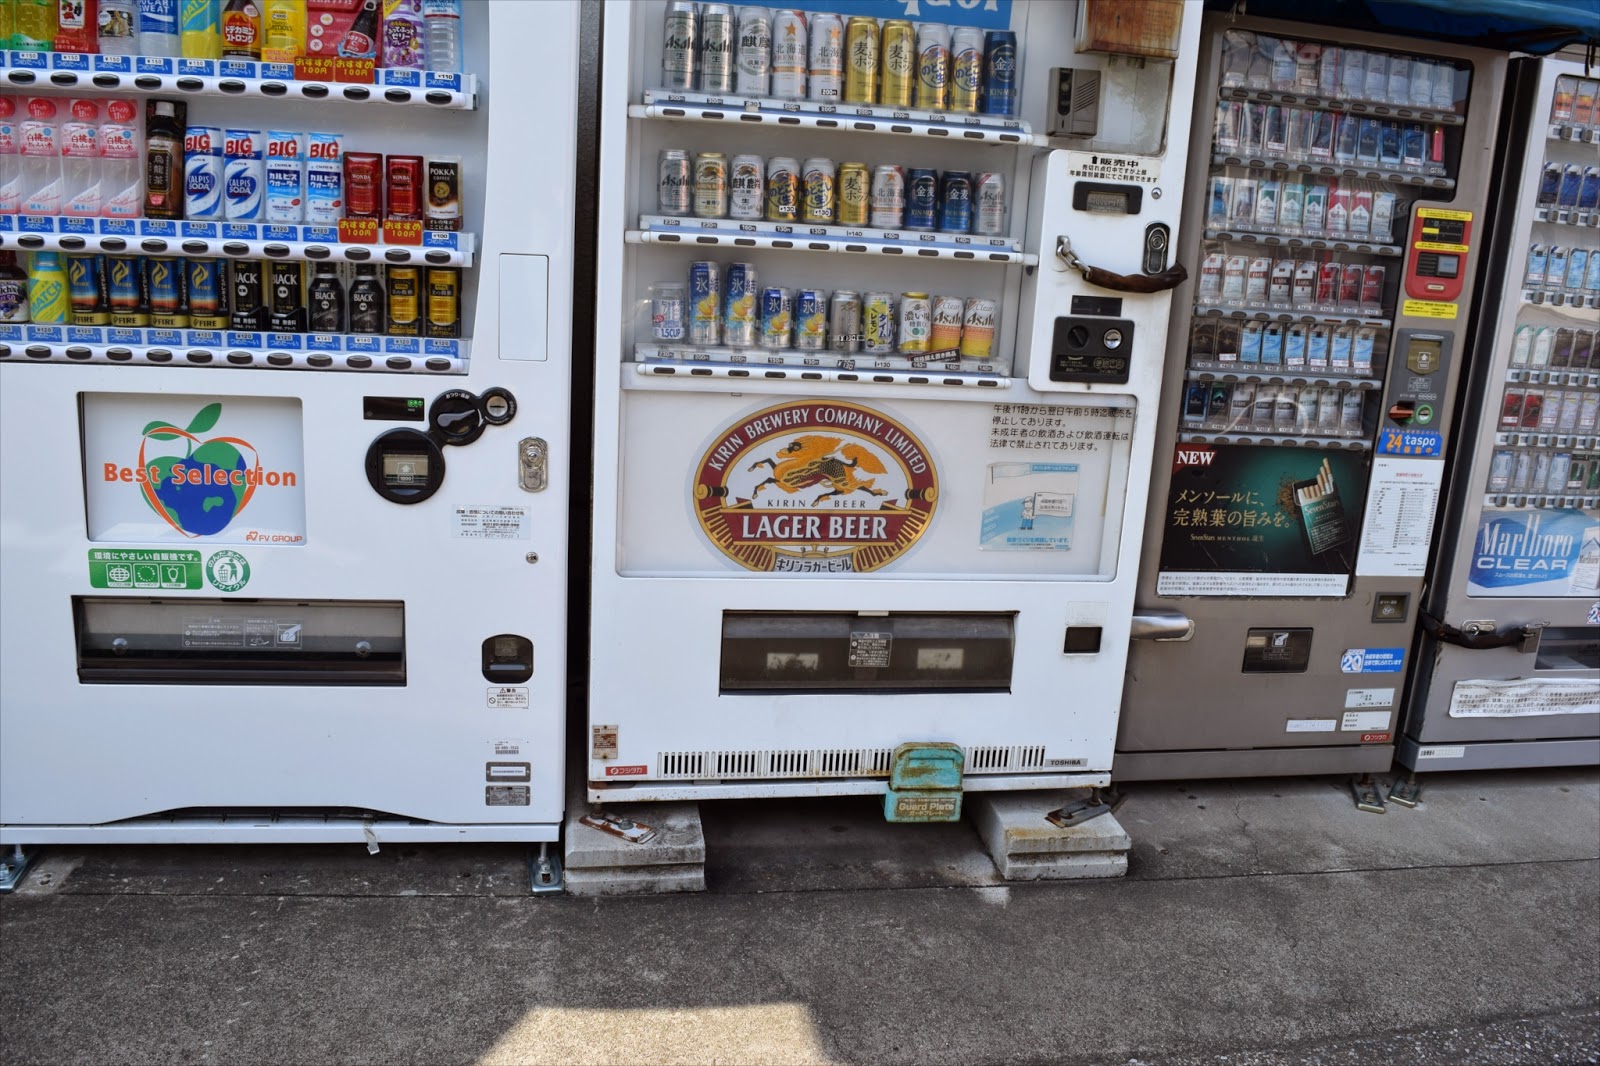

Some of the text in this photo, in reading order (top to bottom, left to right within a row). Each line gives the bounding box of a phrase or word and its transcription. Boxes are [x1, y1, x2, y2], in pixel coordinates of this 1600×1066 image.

[226, 26, 254, 34] ドデカミン
[388, 27, 415, 35] ふってふって
[226, 34, 254, 43] ストロング
[676, 52, 685, 60] 生
[296, 58, 333, 68] おすすめ
[336, 60, 374, 69] おすすめ
[994, 56, 1016, 71] 金麦
[78, 110, 88, 118] 甘い
[185, 134, 211, 151] BIG
[226, 138, 252, 154] BIG
[268, 140, 298, 156] BIG
[310, 142, 338, 158] BIG
[1100, 158, 1139, 168] 販売中
[153, 155, 165, 185] 烏龍茶
[430, 168, 454, 176] POKKA
[1082, 165, 1147, 176] 売切れ点灯中ですが上部
[188, 175, 210, 184] CALPIS
[228, 178, 250, 187] CALPIS
[268, 172, 298, 181] カルピス
[310, 174, 338, 182] カルピス
[1070, 171, 1158, 183] 年齢識別装置にてご利用できます
[732, 178, 760, 189] 麒麟
[770, 182, 798, 197] のどごし
[230, 186, 252, 194] SODA
[916, 186, 934, 198] 金麦
[950, 189, 968, 200] 金麦
[340, 220, 376, 230] おすすめ
[385, 222, 422, 231] おすすめ
[696, 278, 719, 292] 氷結
[732, 278, 756, 294] 氷結
[30, 281, 63, 313] MATCH
[315, 292, 336, 300] BLACK
[354, 294, 374, 302] BLACK
[769, 299, 790, 312] 氷結
[802, 300, 825, 314] 氷結
[77, 316, 94, 324] FIRE
[158, 318, 176, 326] FIRE
[904, 312, 930, 322] 濃い味
[878, 314, 888, 337] タイム
[992, 416, 1067, 428] 停止しております。
[709, 407, 926, 474] KIRIN BREWERY COMPANY, LIMITED
[990, 428, 1130, 441] 未成年者の飲酒および飲酒運転は
[1386, 433, 1436, 448] 24 taspo
[990, 439, 1099, 452] 法律で禁止されております。
[1176, 450, 1216, 466] NEW
[104, 462, 296, 486] Best Selection
[768, 499, 866, 508] KIRIN BEER
[1175, 489, 1266, 507] メンソールに、
[1172, 508, 1293, 529] 完熟葉の旨みを。
[742, 516, 888, 540] LAGER BEER
[1190, 534, 1216, 542] SevenStars
[1252, 534, 1265, 542] 誕生
[1479, 514, 1574, 557] Marlboro
[94, 552, 198, 562] 環境にやさしい自販機です。
[208, 550, 246, 567] のんだあとは
[776, 558, 852, 572] キリンラガービール
[1476, 557, 1568, 570] CLEAR
[211, 578, 246, 592] リサイクル
[1342, 654, 1362, 671] 20
[899, 802, 954, 812] Guard Plate
